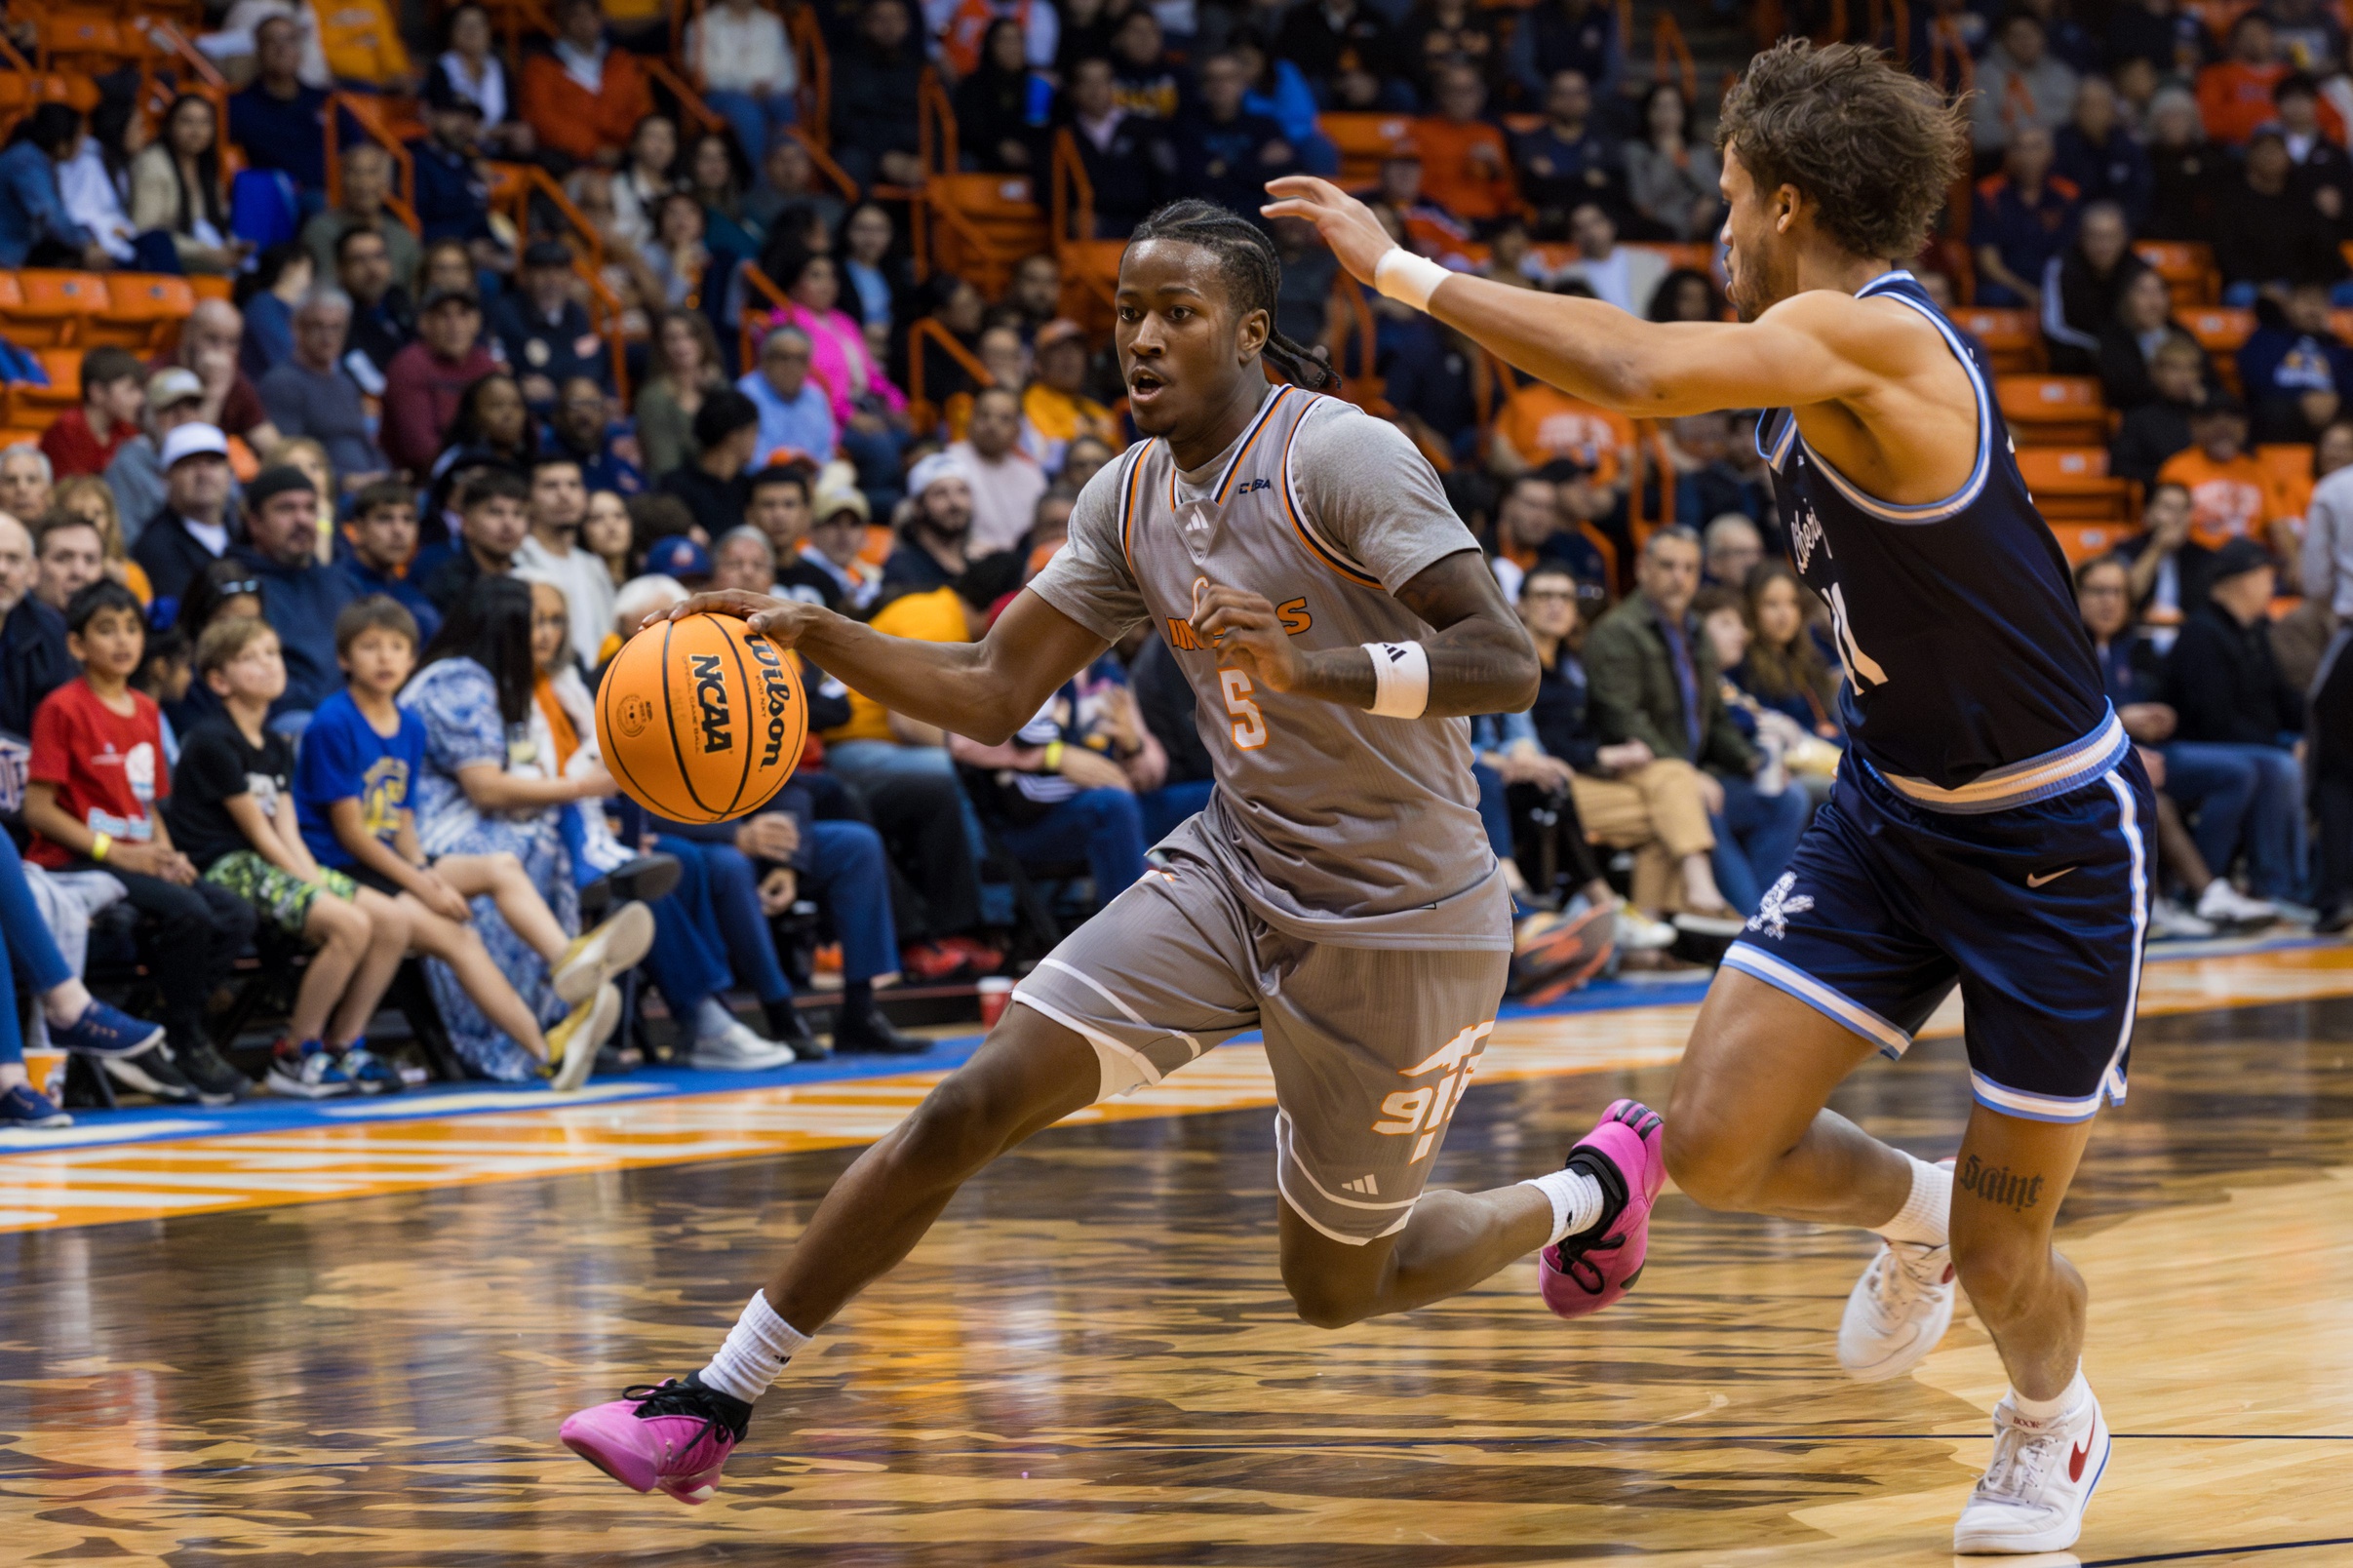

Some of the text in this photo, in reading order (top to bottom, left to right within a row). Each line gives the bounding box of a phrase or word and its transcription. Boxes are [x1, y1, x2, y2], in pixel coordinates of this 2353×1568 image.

[689, 653, 732, 754] NCAA
[689, 696, 698, 725] GAME
[744, 634, 791, 767] Wilson
[756, 675, 765, 695] EVO
[1218, 667, 1269, 752] 5
[1959, 1155, 2044, 1213] Saint
[2013, 1416, 2042, 1429] BOOK
